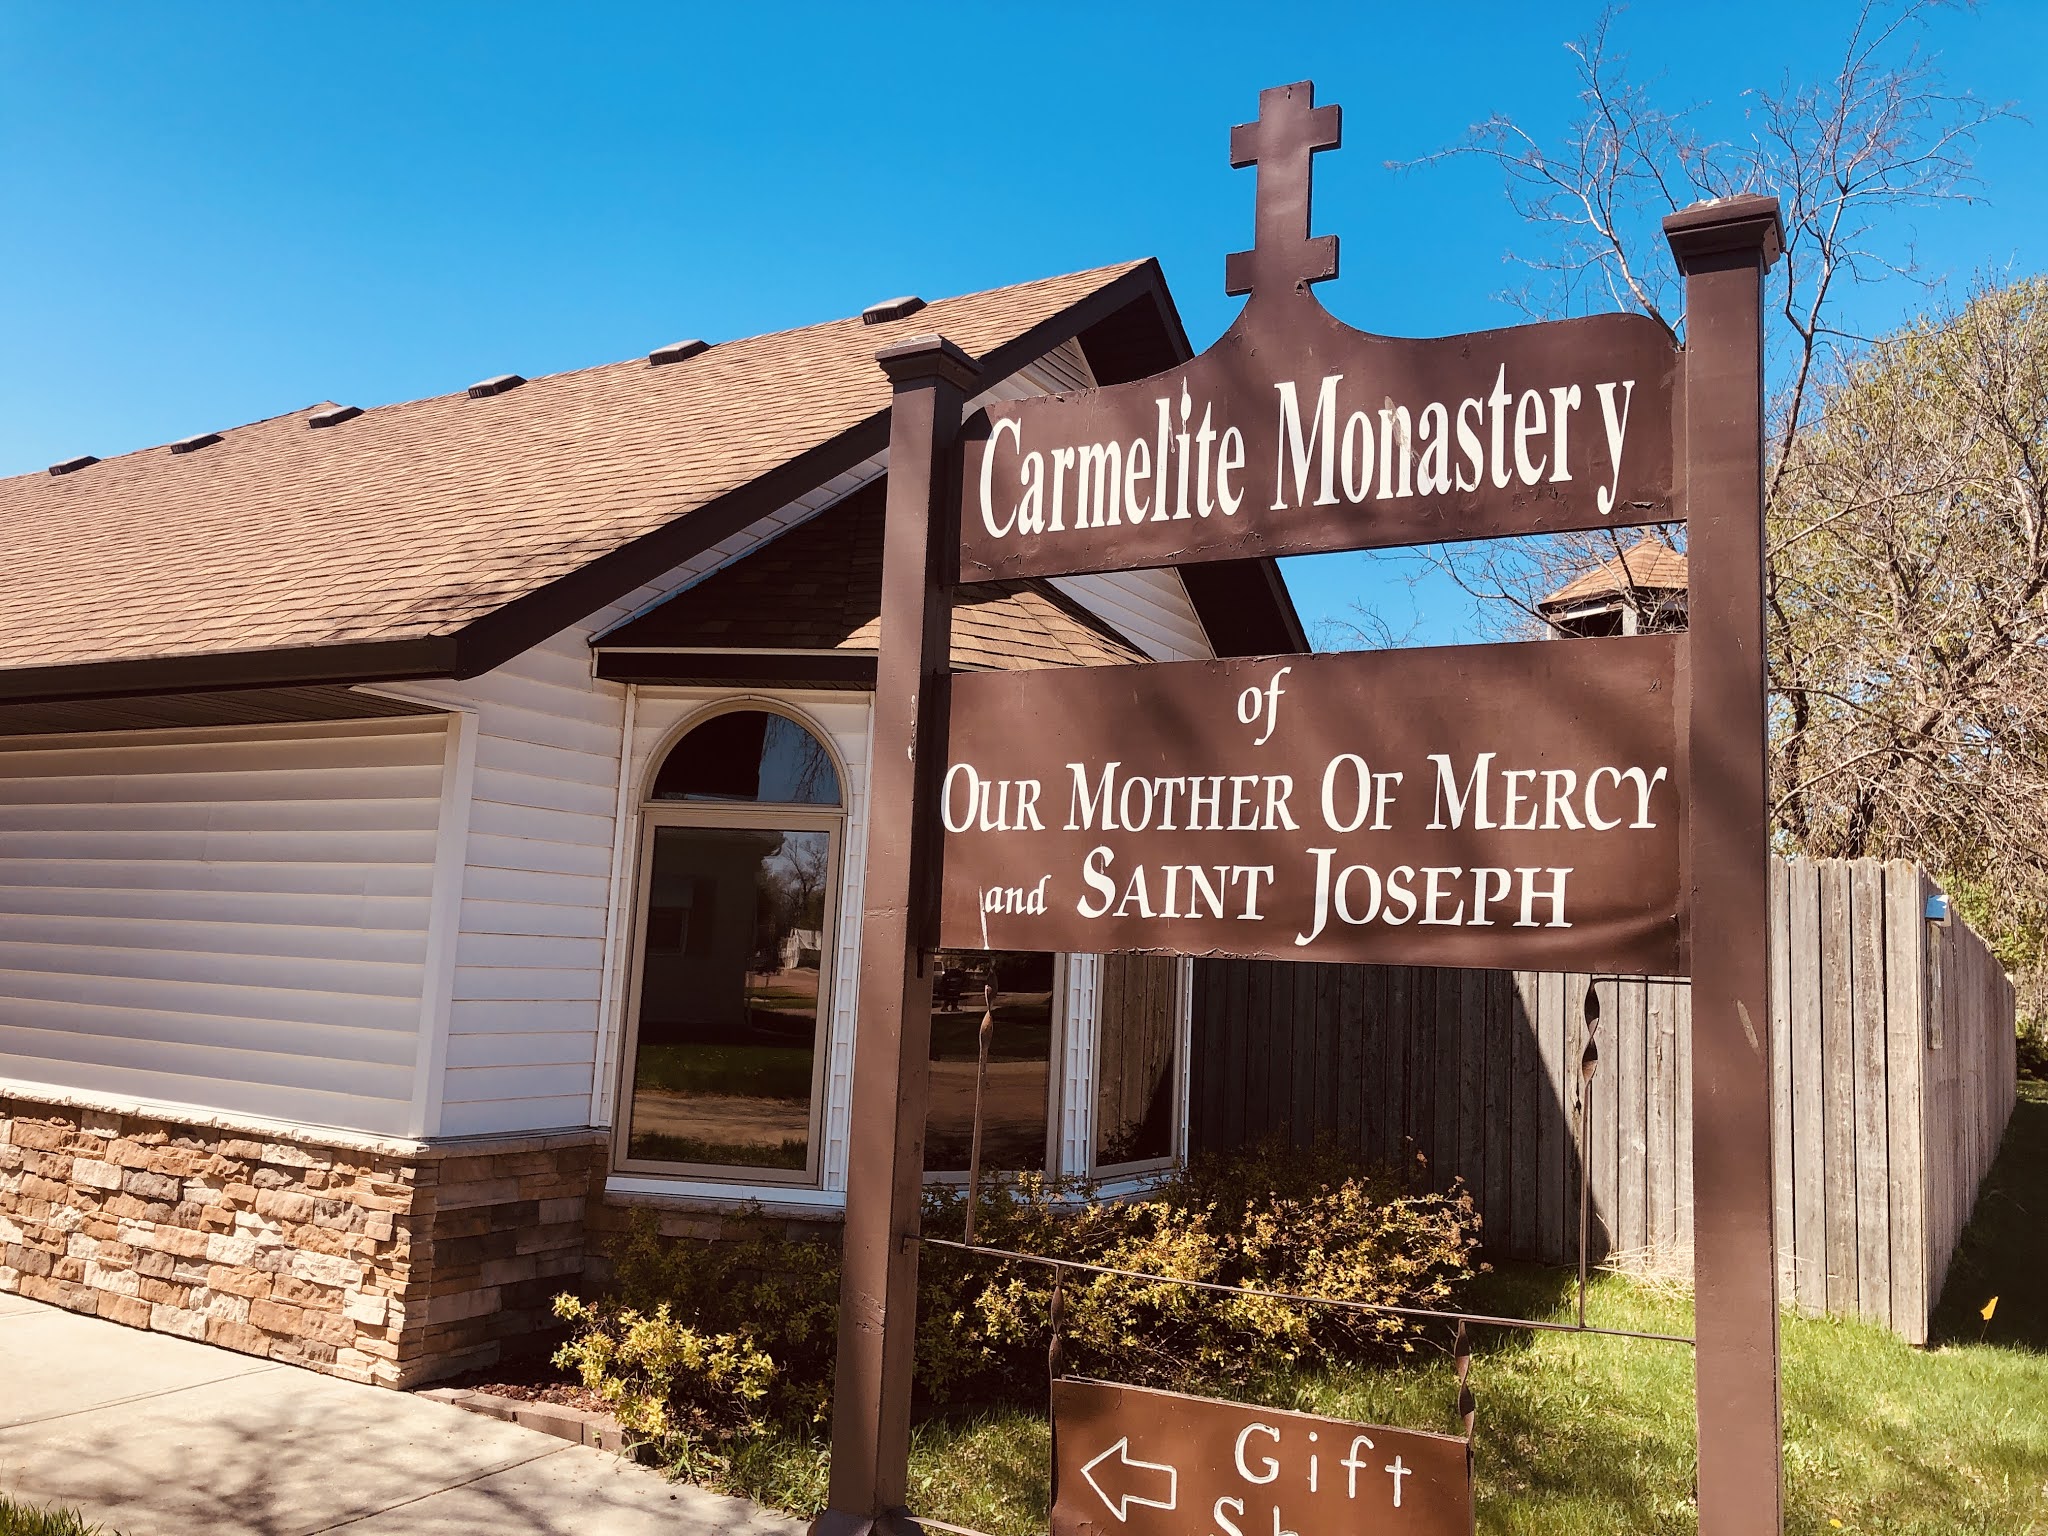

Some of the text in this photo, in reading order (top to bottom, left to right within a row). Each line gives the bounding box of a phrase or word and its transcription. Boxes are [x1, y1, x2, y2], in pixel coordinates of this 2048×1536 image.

[979, 363, 1636, 539] Carmelite Monastery
[1237, 666, 1292, 746] of
[941, 752, 1668, 833] OUR MOTHER OF MERCY
[984, 845, 1574, 946] and SAINT JOSEPH
[1234, 1422, 1412, 1508] Gift
